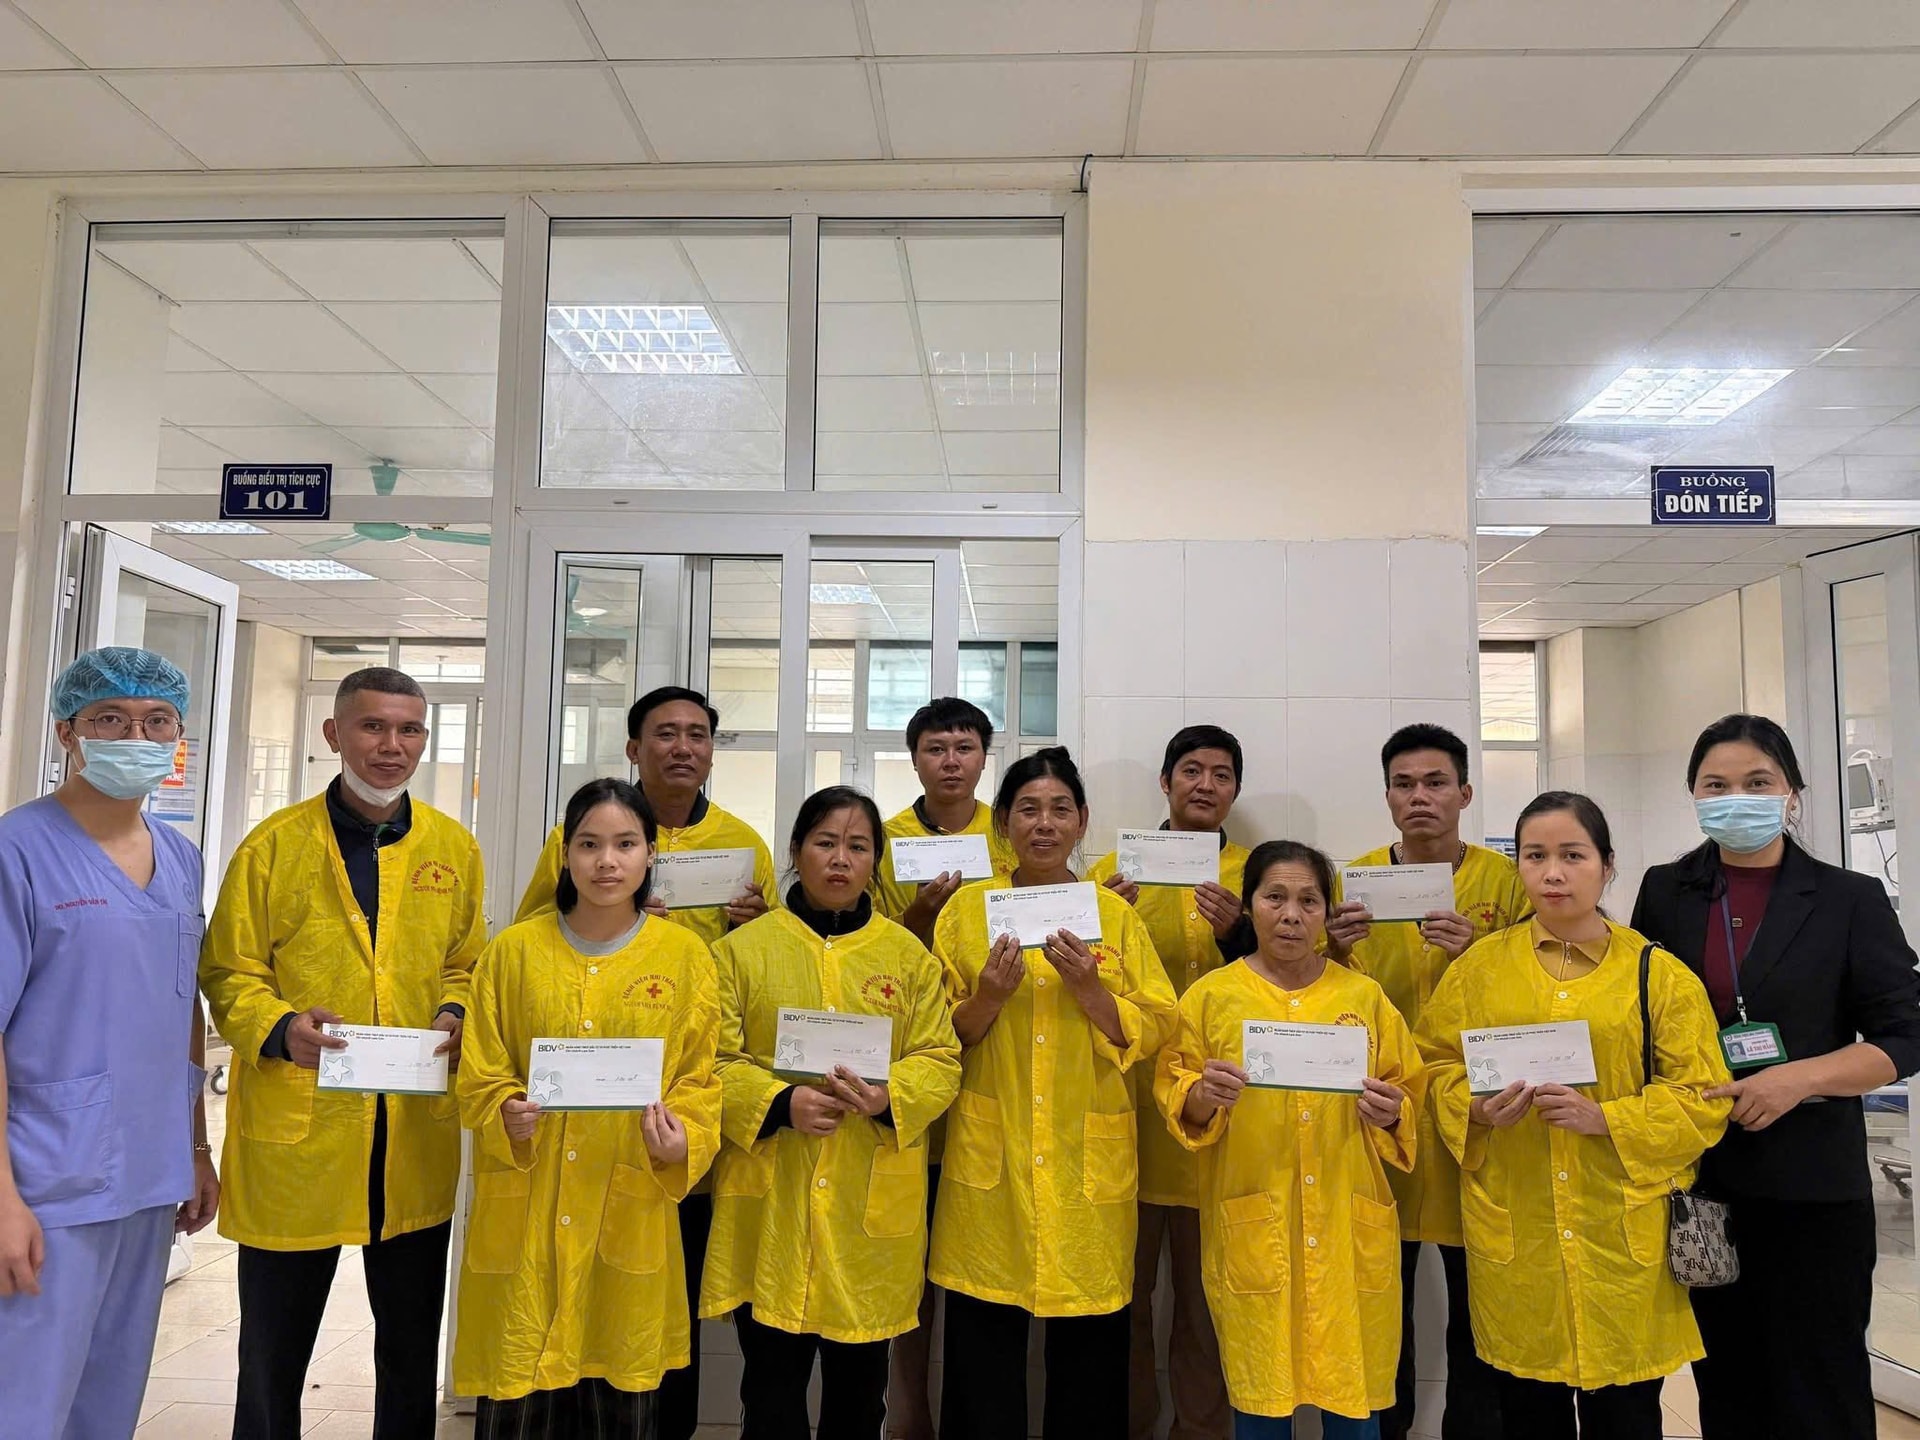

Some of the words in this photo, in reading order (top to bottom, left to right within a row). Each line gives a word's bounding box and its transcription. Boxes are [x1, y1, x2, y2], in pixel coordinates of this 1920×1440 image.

[276, 474, 288, 488] TRỊ
[288, 471, 305, 485] TÍCH
[243, 490, 308, 510] 101
[1664, 489, 1710, 513] ĐÓN
[1716, 488, 1763, 513] TIẾP
[990, 894, 1006, 902] BIDV
[783, 1014, 800, 1022] BIDV
[1249, 1025, 1267, 1034] BIDV
[1468, 1034, 1486, 1043] BIDV
[538, 1044, 558, 1052] BIDV
